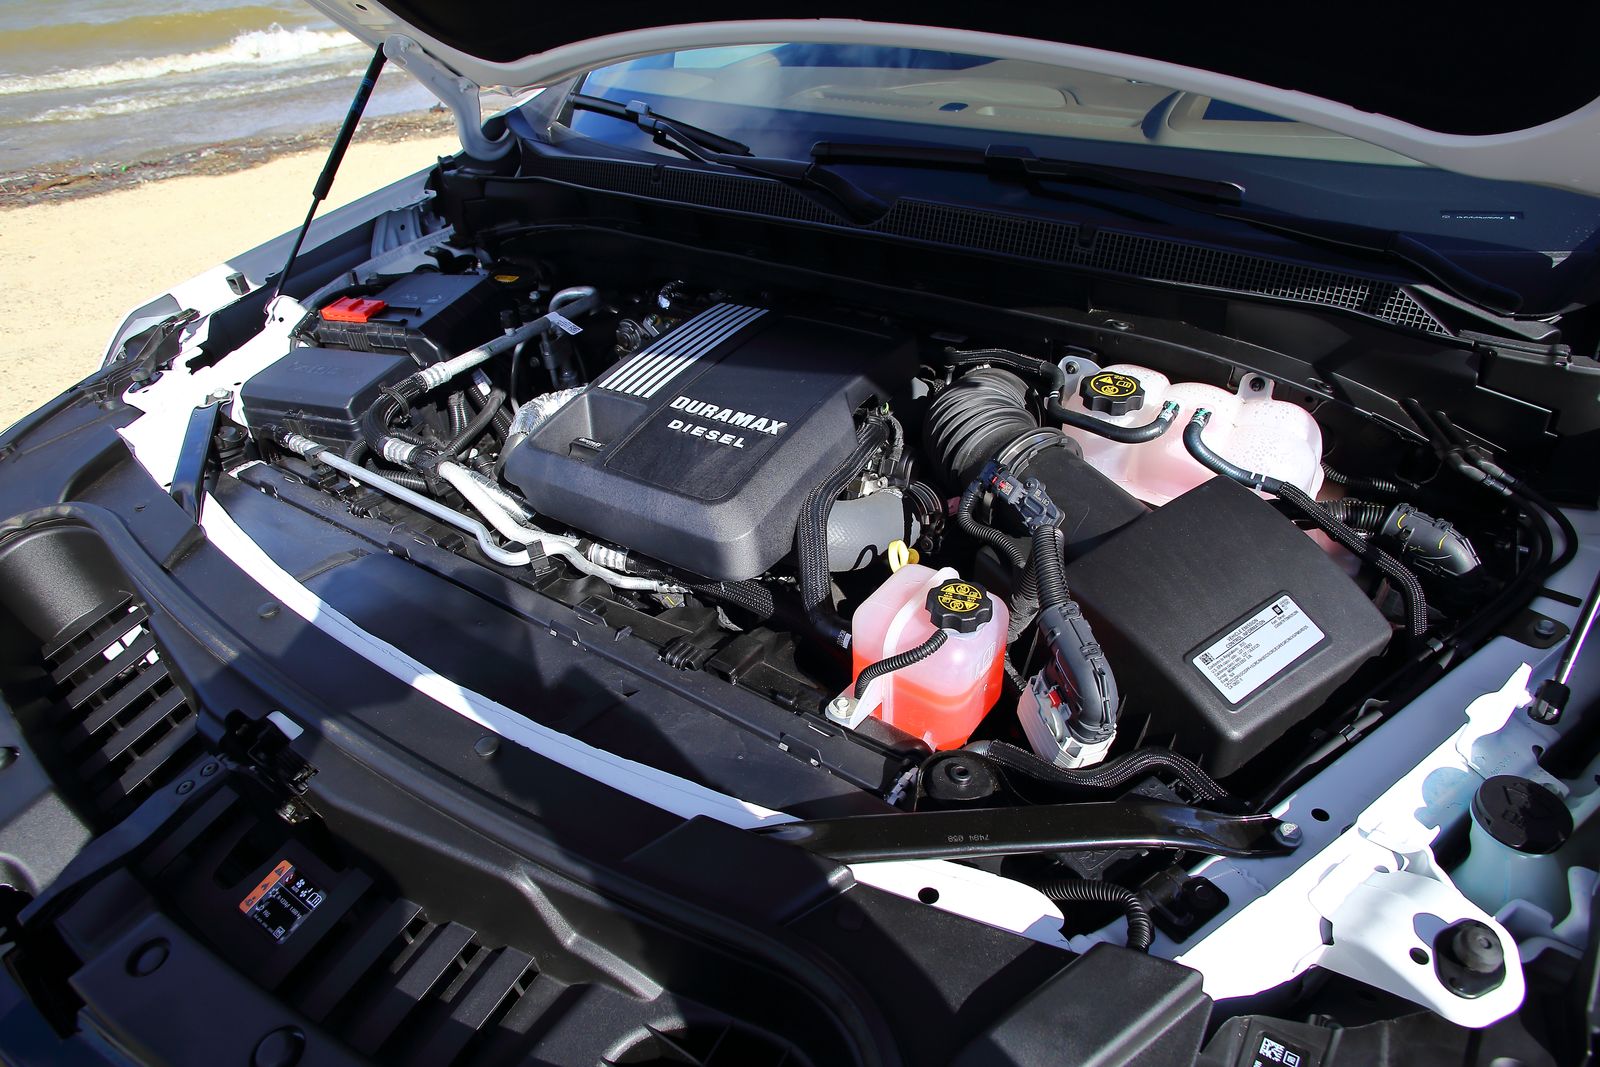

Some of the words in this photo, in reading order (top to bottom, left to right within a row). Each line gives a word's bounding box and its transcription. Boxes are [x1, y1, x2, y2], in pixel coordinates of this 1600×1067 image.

[669, 395, 788, 435] DURAMAX
[667, 419, 745, 449] DIESEL
[1225, 635, 1243, 648] CONTROL
[1242, 619, 1265, 637] INFORMATION
[1226, 629, 1242, 641] VEHICLE
[1241, 618, 1258, 631] EMISSION
